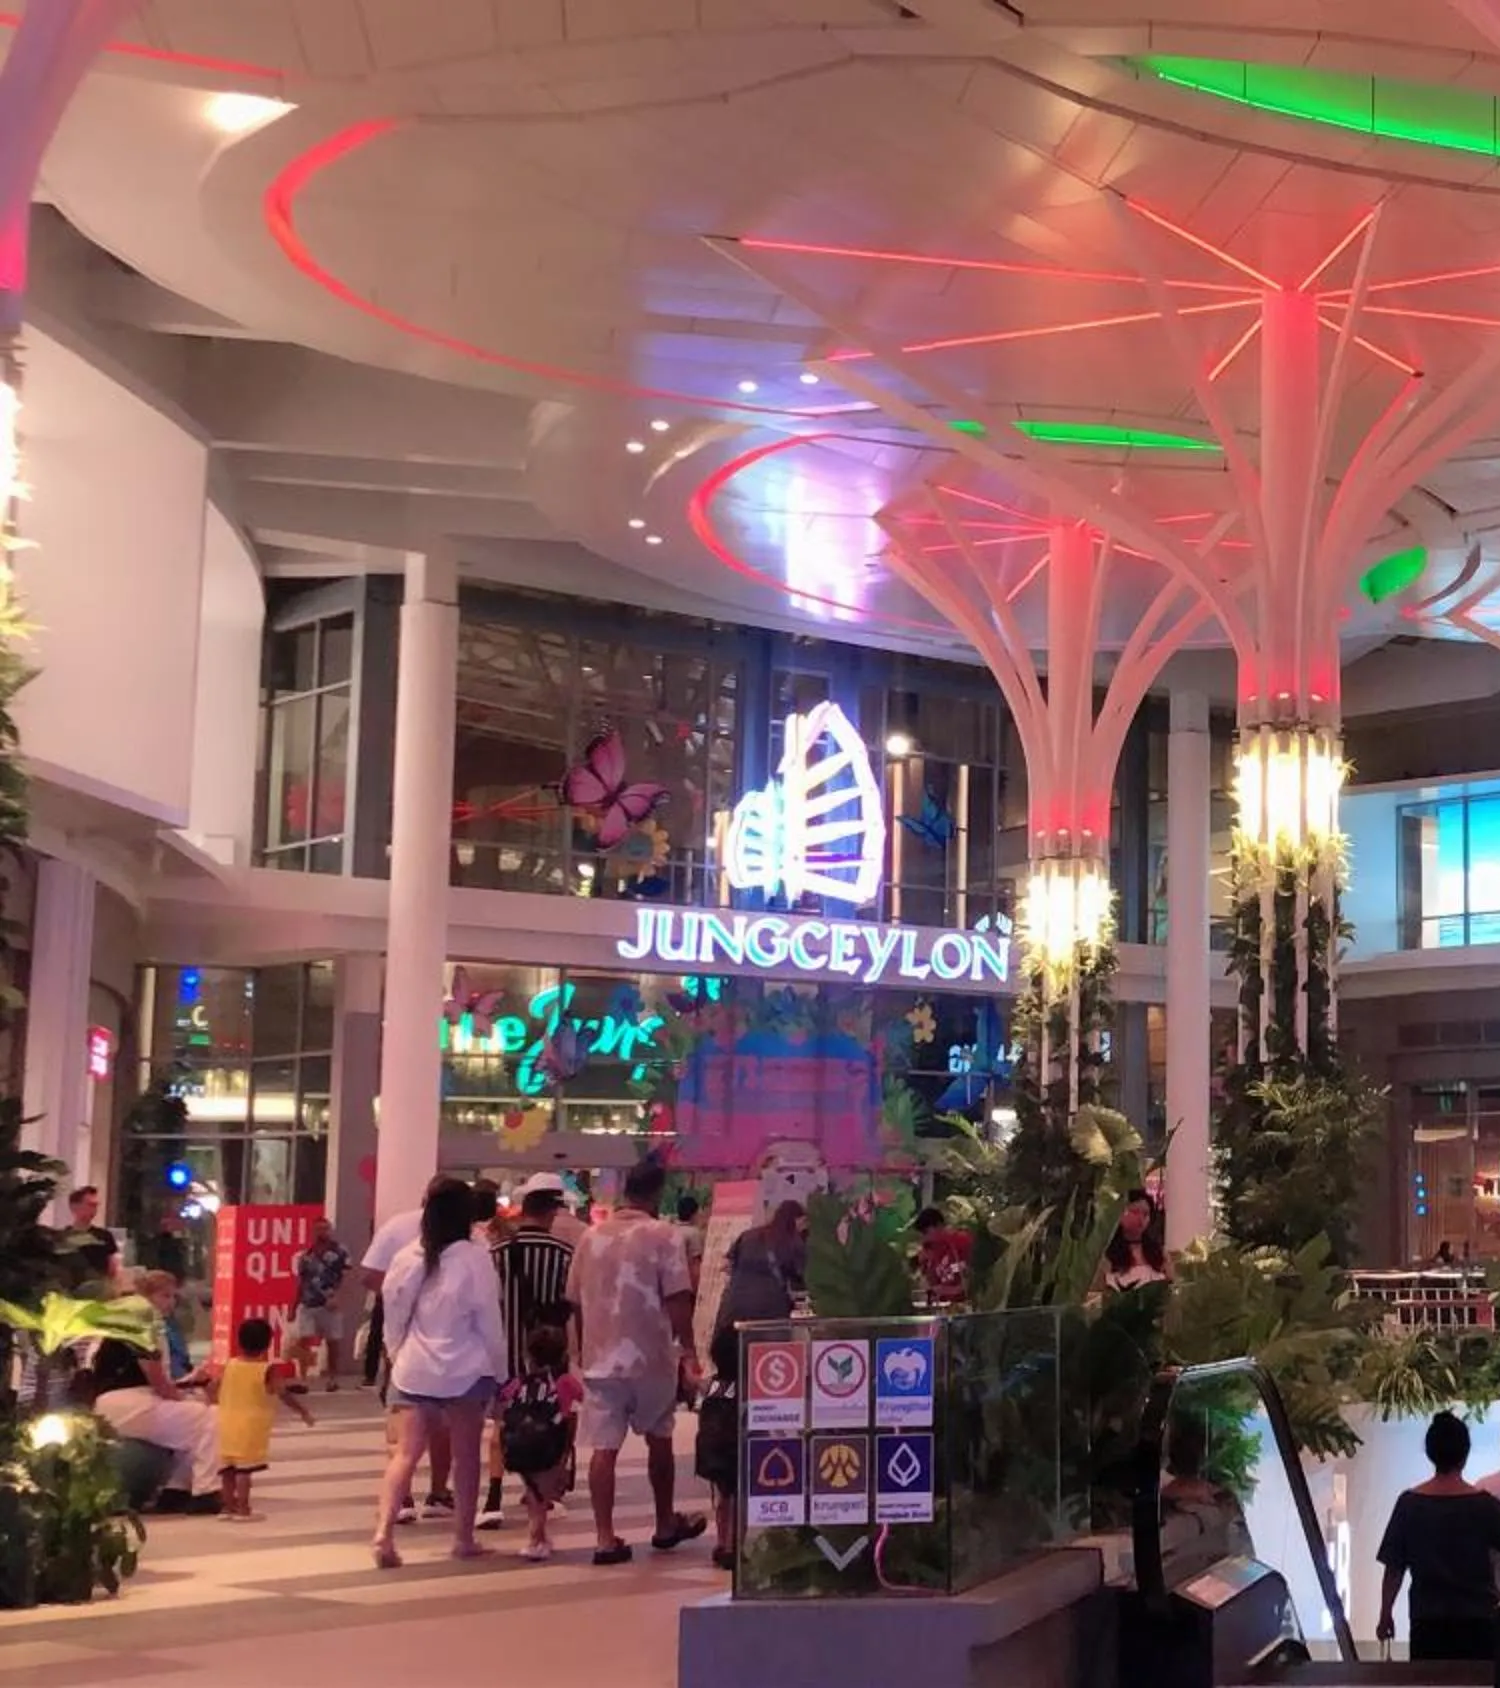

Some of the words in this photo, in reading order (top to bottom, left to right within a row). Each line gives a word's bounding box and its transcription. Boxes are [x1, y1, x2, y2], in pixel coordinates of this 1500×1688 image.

[616, 907, 1011, 983] JUNGCEYLON
[246, 1217, 307, 1246] UNI
[760, 1501, 789, 1513] SCB
